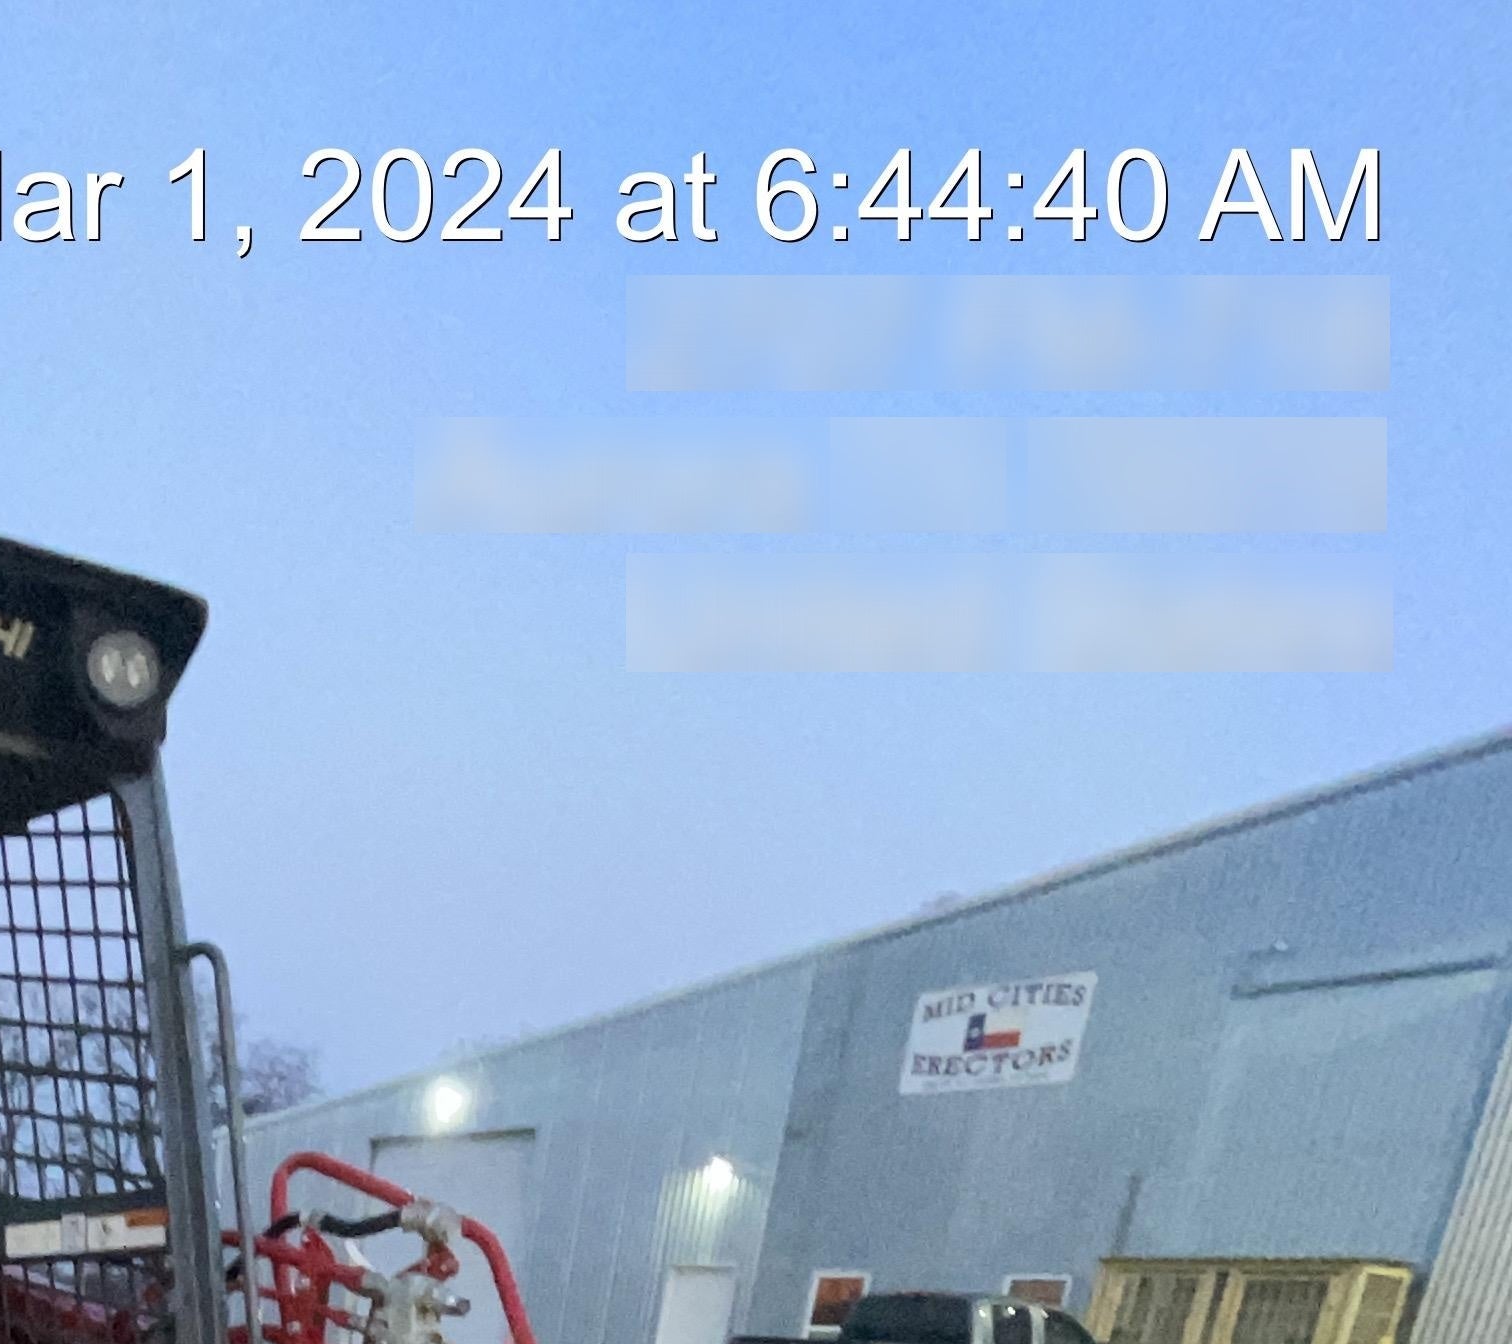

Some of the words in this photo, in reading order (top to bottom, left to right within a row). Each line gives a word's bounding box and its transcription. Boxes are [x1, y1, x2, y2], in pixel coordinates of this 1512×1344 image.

[922, 992, 976, 1023] MID
[988, 982, 1088, 1010] CITIES
[910, 1039, 1073, 1076] ERECTORS
